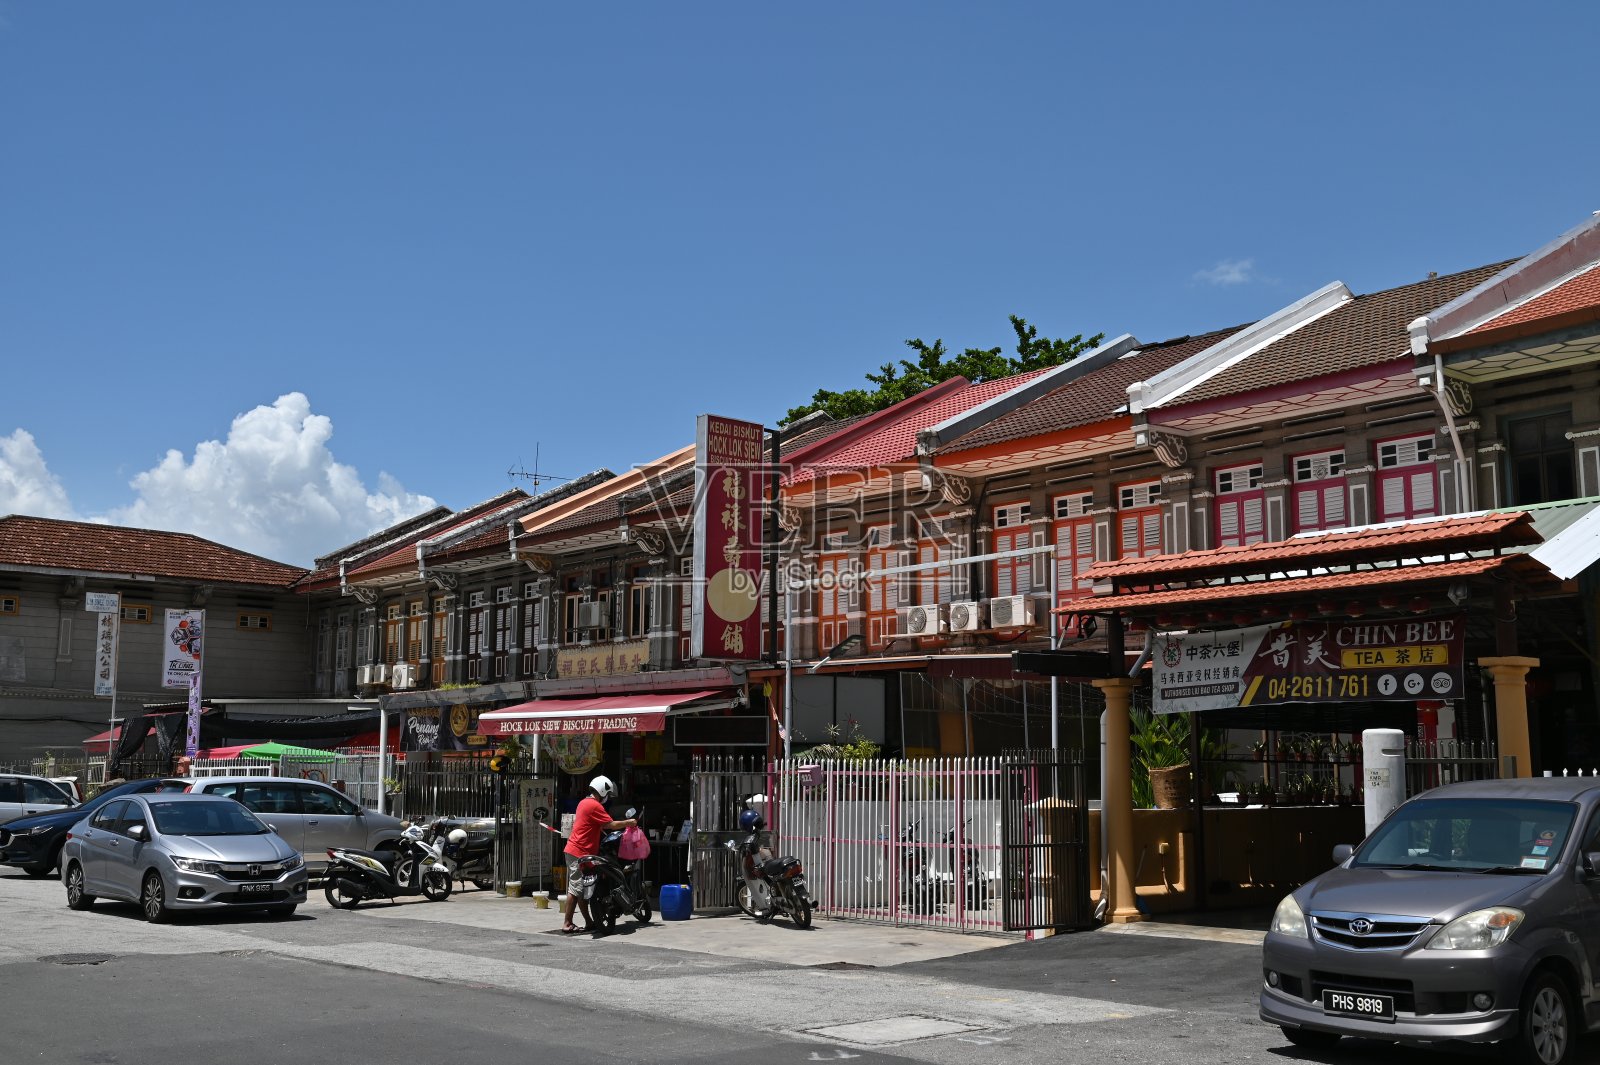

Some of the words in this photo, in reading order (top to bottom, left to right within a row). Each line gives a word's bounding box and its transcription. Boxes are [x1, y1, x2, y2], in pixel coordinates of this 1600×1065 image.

[710, 421, 732, 435] KEDAI
[733, 425, 760, 440] BISKUT
[708, 434, 728, 455] HOCK
[729, 438, 743, 457] LOK
[744, 440, 761, 460] SIEW
[1336, 624, 1399, 646] CHIN
[1404, 619, 1455, 643] BEE
[1186, 640, 1240, 661] 中茶六堡
[1354, 651, 1385, 665] TEA
[1211, 685, 1221, 693] TEA
[1268, 676, 1333, 700] 04-2611
[1338, 674, 1369, 697] 761
[407, 716, 440, 736] Penang
[499, 721, 523, 732] HOCK
[524, 720, 540, 732] LOK
[542, 720, 561, 731] SIEW
[562, 719, 596, 731] BISCUIT
[597, 717, 637, 729] TRADING
[1332, 994, 1354, 1010] PHS
[1356, 997, 1383, 1014] 9819
